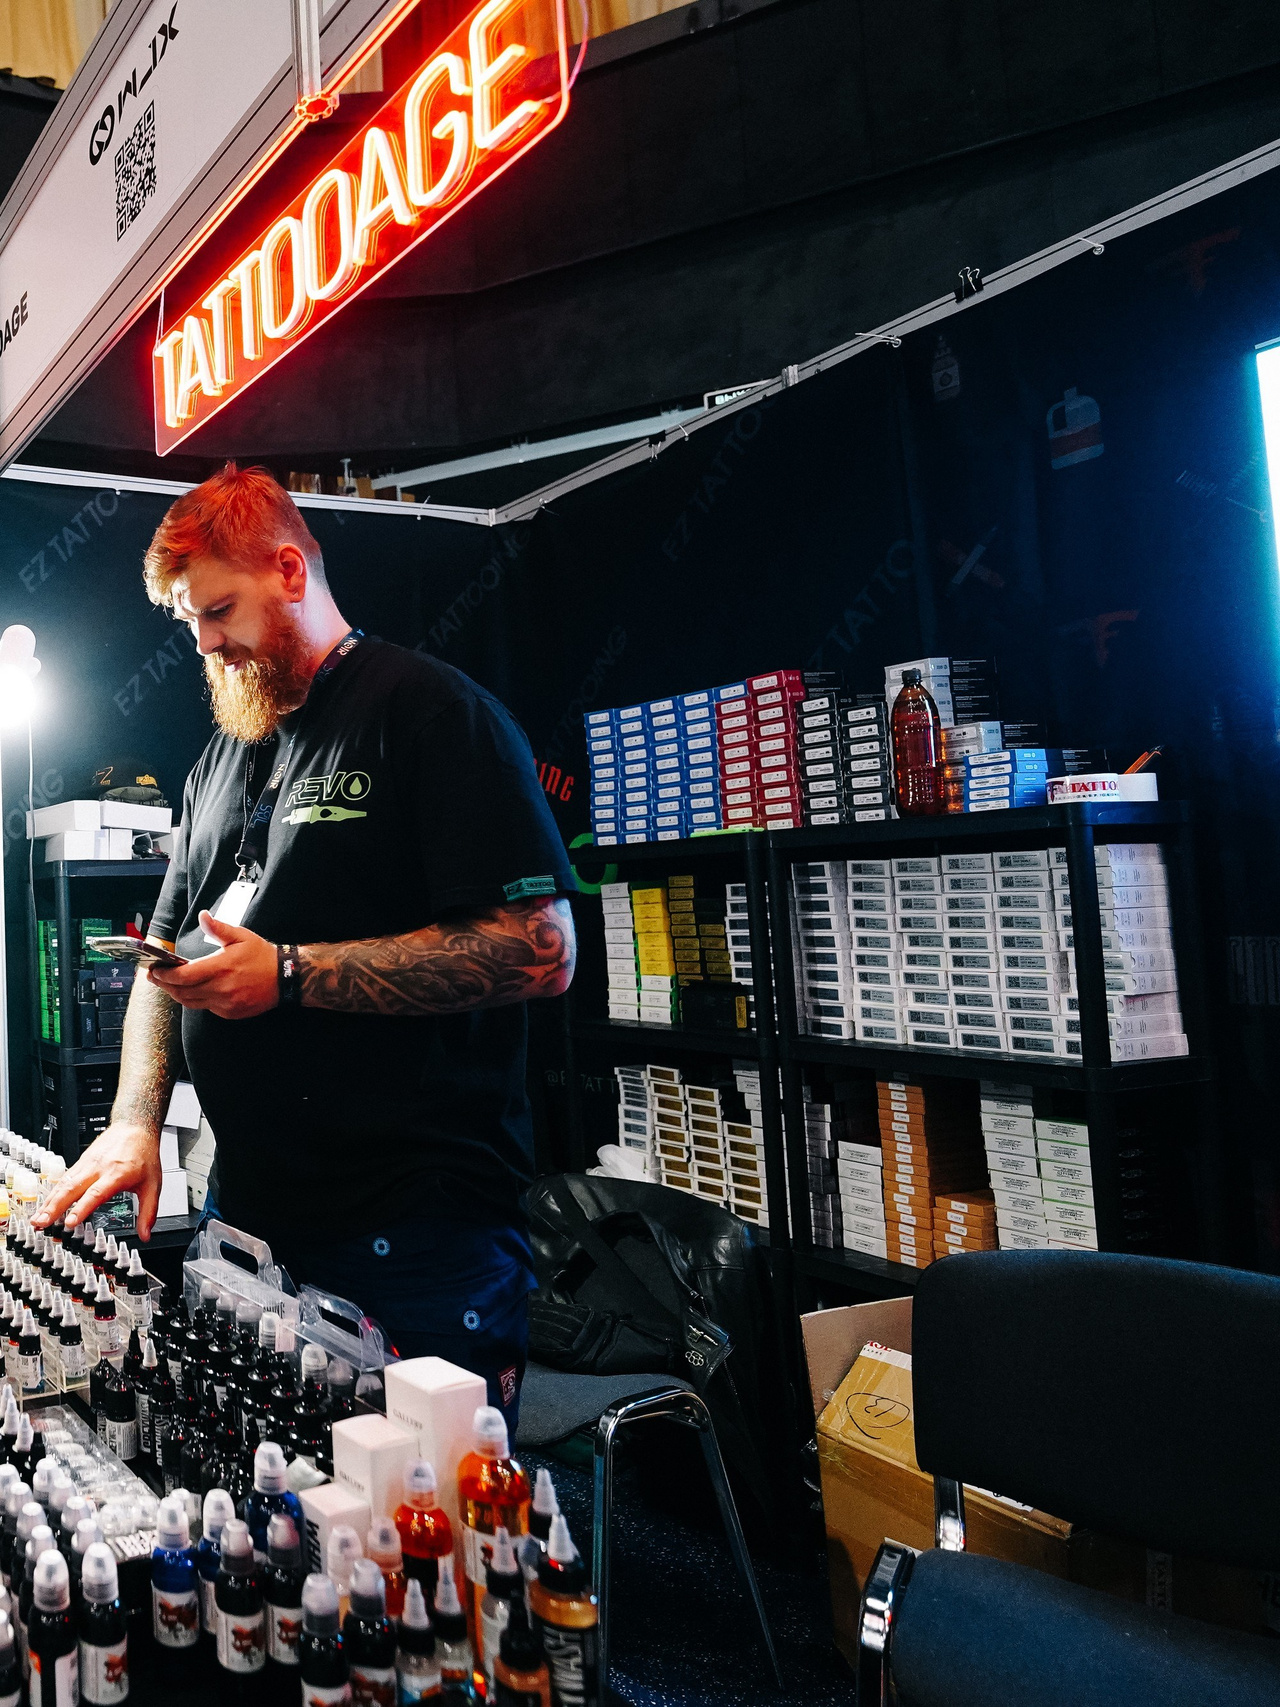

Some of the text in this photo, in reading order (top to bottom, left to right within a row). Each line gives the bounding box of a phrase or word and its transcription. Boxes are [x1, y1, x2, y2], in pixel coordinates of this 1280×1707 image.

[155, 0, 551, 430] TATTOOAGE
[47, 491, 119, 563] TATTO
[285, 771, 372, 808] REVO
[1071, 780, 1119, 793] TATTO
[525, 881, 552, 889] TATTOO
